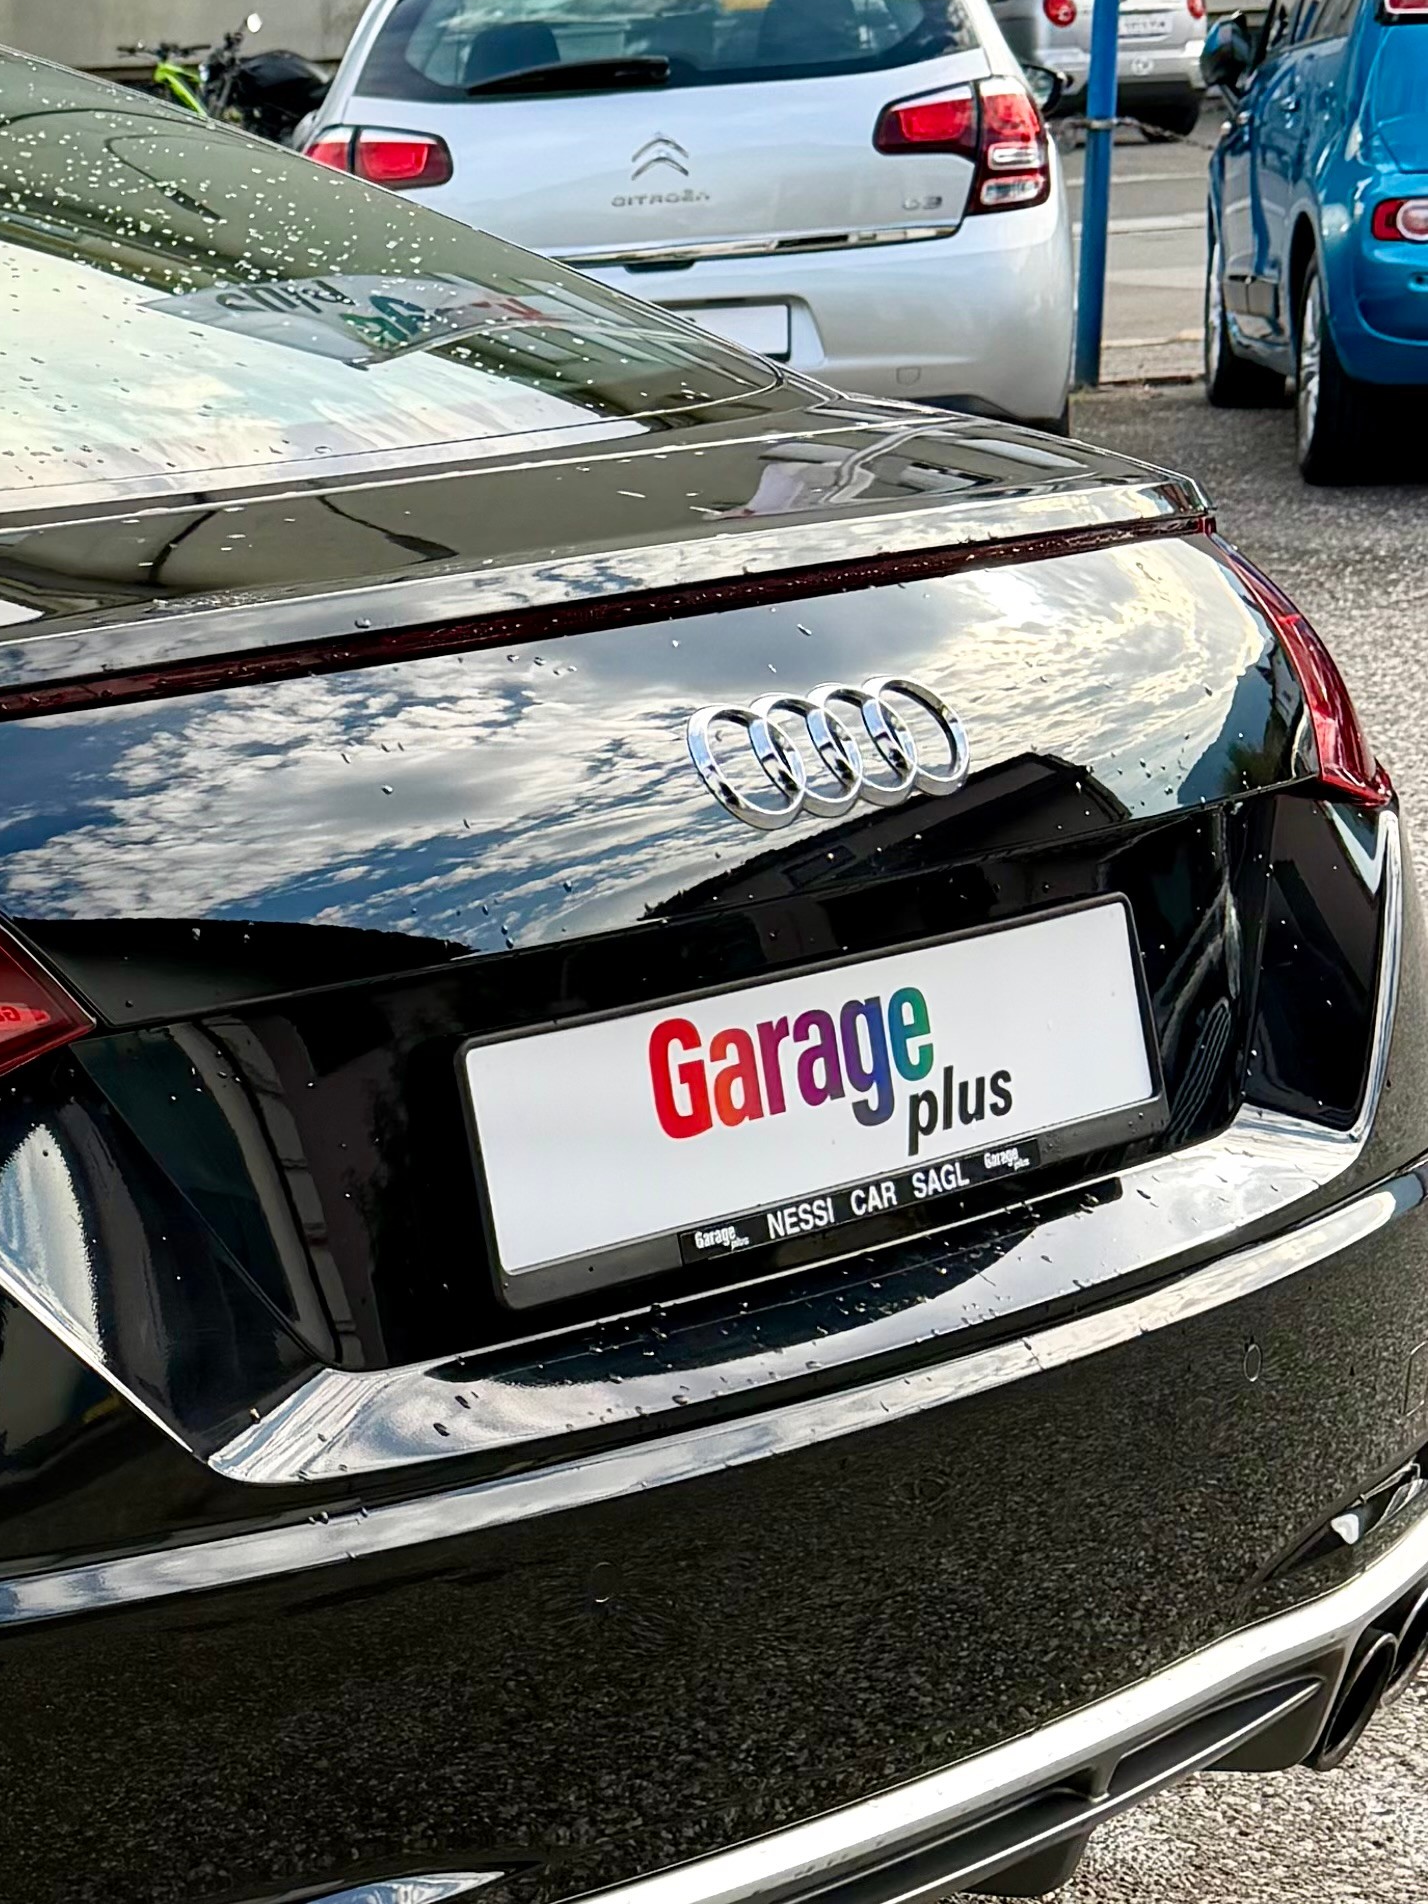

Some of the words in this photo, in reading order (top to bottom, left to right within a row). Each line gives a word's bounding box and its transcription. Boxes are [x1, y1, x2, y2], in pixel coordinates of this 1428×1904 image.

[648, 986, 934, 1139] Garage
[907, 1065, 1013, 1156] plus
[983, 1145, 1020, 1170] Garage
[1013, 1157, 1031, 1171] plus
[767, 1197, 835, 1240] NESSI
[851, 1181, 898, 1216] CAR
[912, 1162, 970, 1199] SAGL
[695, 1225, 736, 1249] Garage
[730, 1235, 750, 1251] plus
